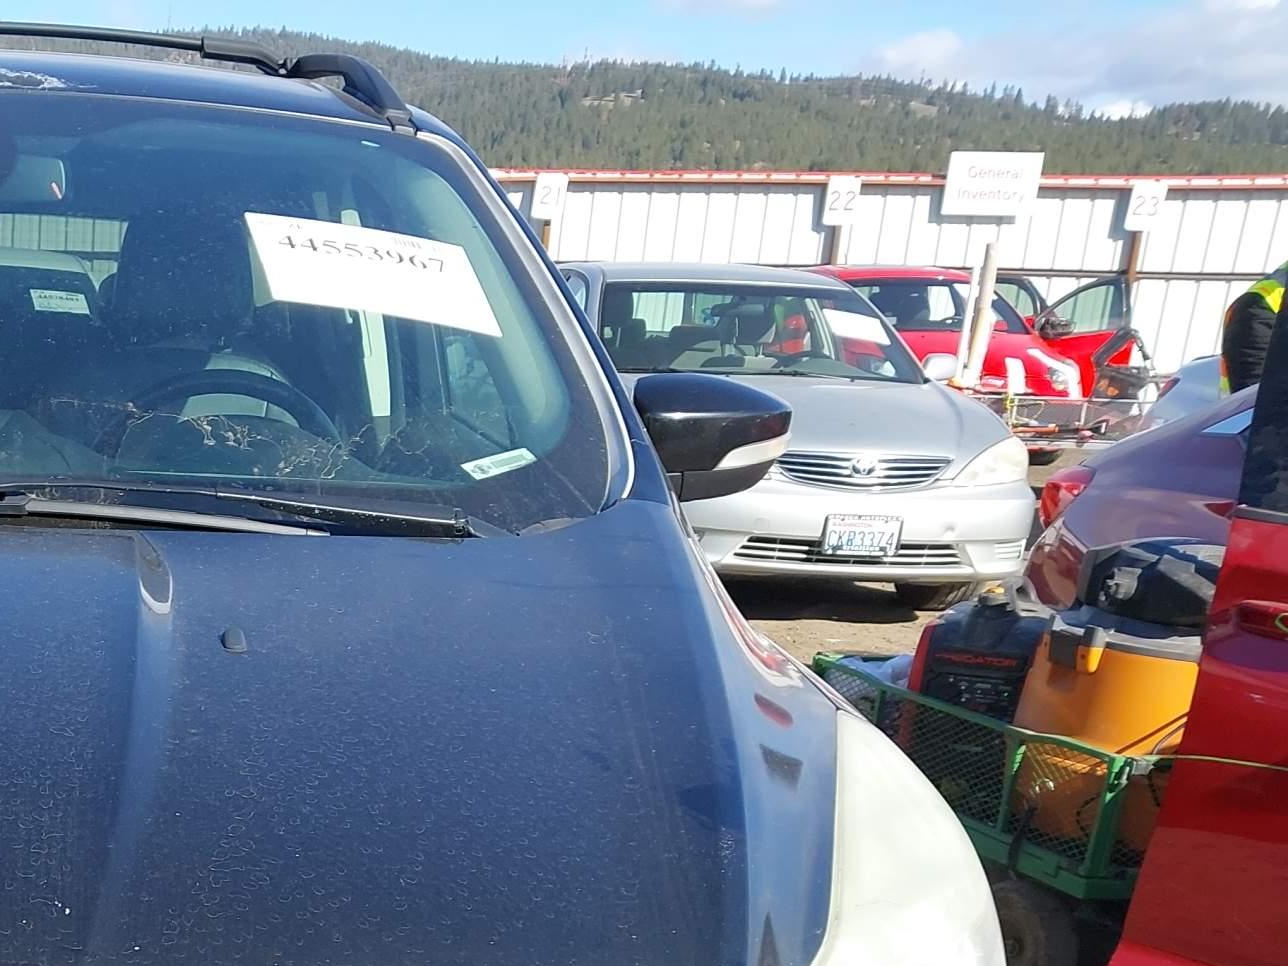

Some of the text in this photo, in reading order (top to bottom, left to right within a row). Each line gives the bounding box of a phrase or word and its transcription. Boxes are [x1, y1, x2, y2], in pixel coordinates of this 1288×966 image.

[968, 166, 1024, 180] General
[540, 185, 561, 206] 21
[829, 190, 857, 211] 22
[957, 187, 1024, 203] Inventory
[1133, 195, 1160, 216] 23
[278, 234, 445, 273] 44553967
